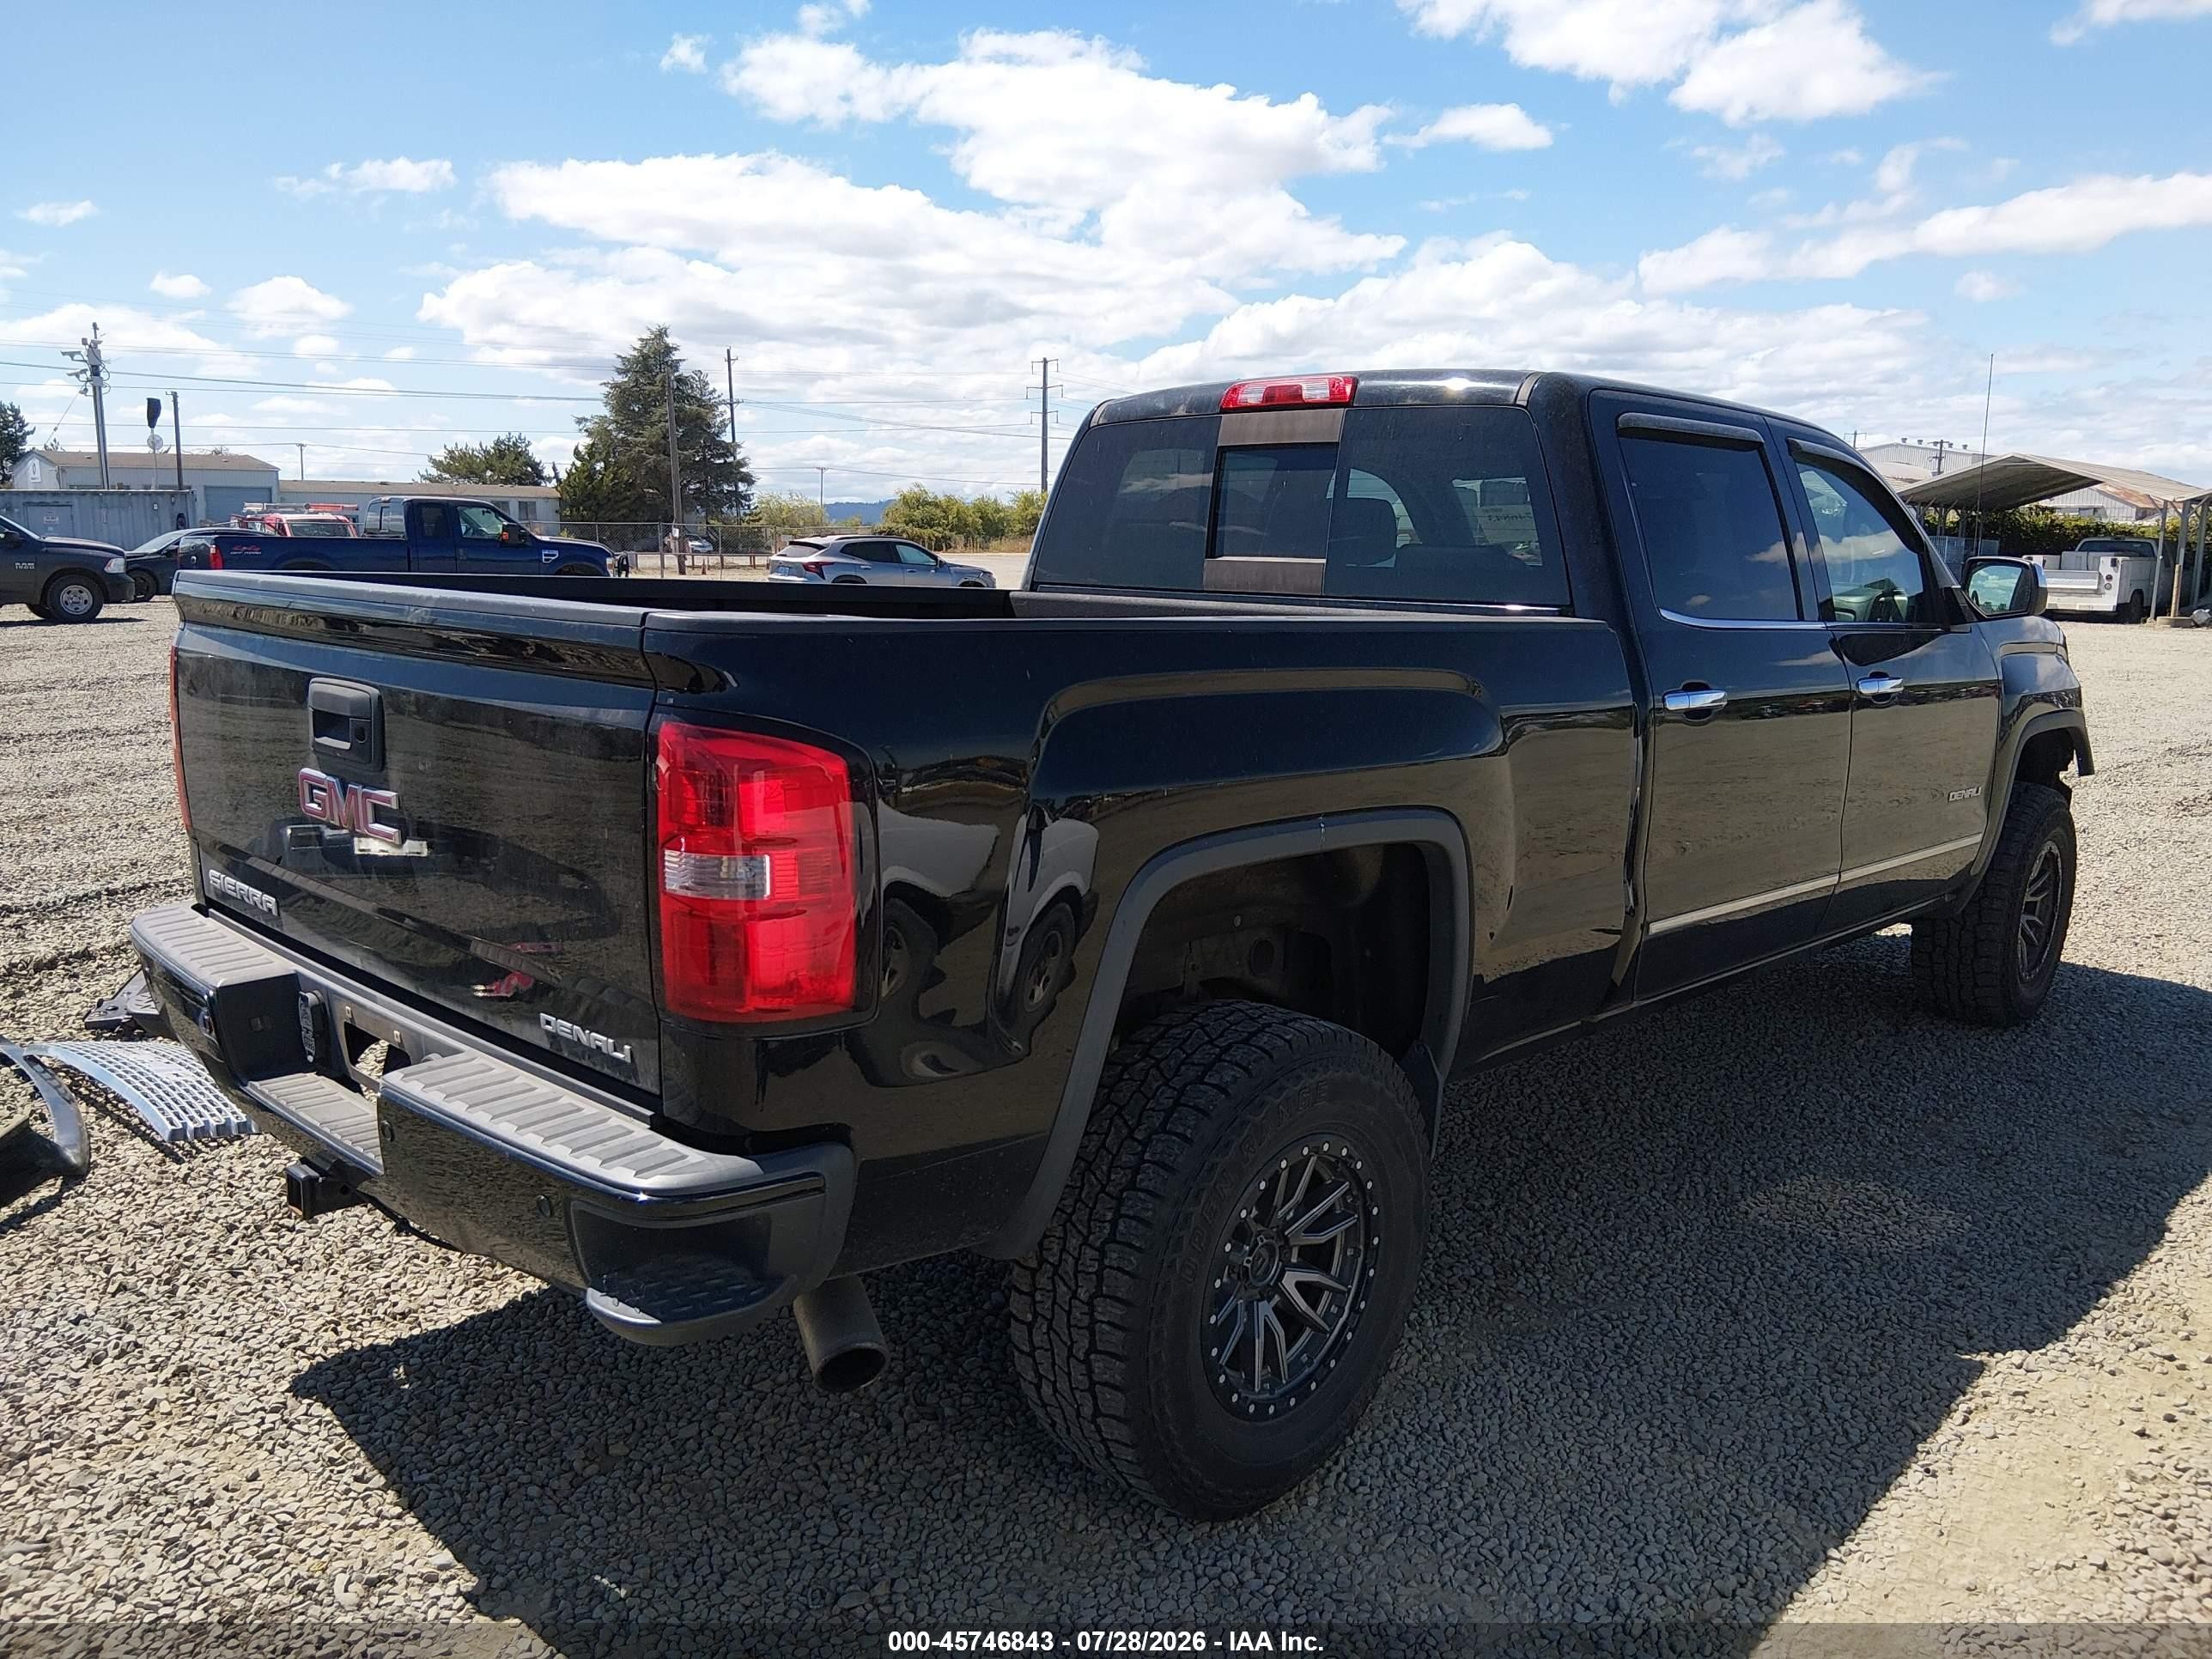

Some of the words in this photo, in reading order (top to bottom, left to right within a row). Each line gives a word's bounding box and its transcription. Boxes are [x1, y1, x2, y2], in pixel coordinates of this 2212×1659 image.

[299, 767, 403, 845] GMC
[1948, 787, 1982, 802] DENALI
[209, 869, 278, 916] SIERRA
[539, 1012, 632, 1063] DENALI
